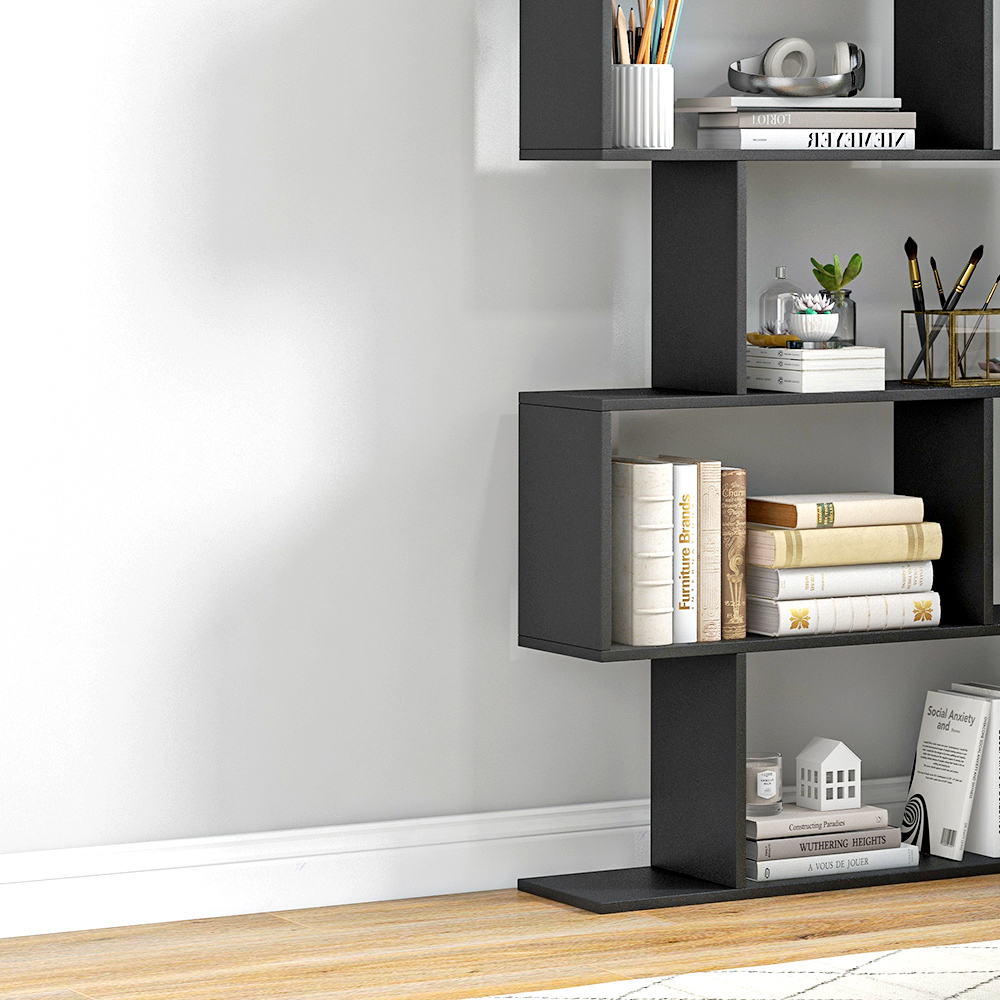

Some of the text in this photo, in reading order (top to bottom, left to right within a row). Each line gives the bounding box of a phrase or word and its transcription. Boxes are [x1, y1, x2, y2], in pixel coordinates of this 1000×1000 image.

[678, 493, 691, 611] Furniture Brands
[927, 705, 976, 727] Social Anxiety
[937, 720, 951, 731] and
[788, 822, 822, 831] Constructing
[799, 835, 887, 852] WUTHERING HEIGHTS
[808, 858, 869, 872] A VOUS DE JOUER
